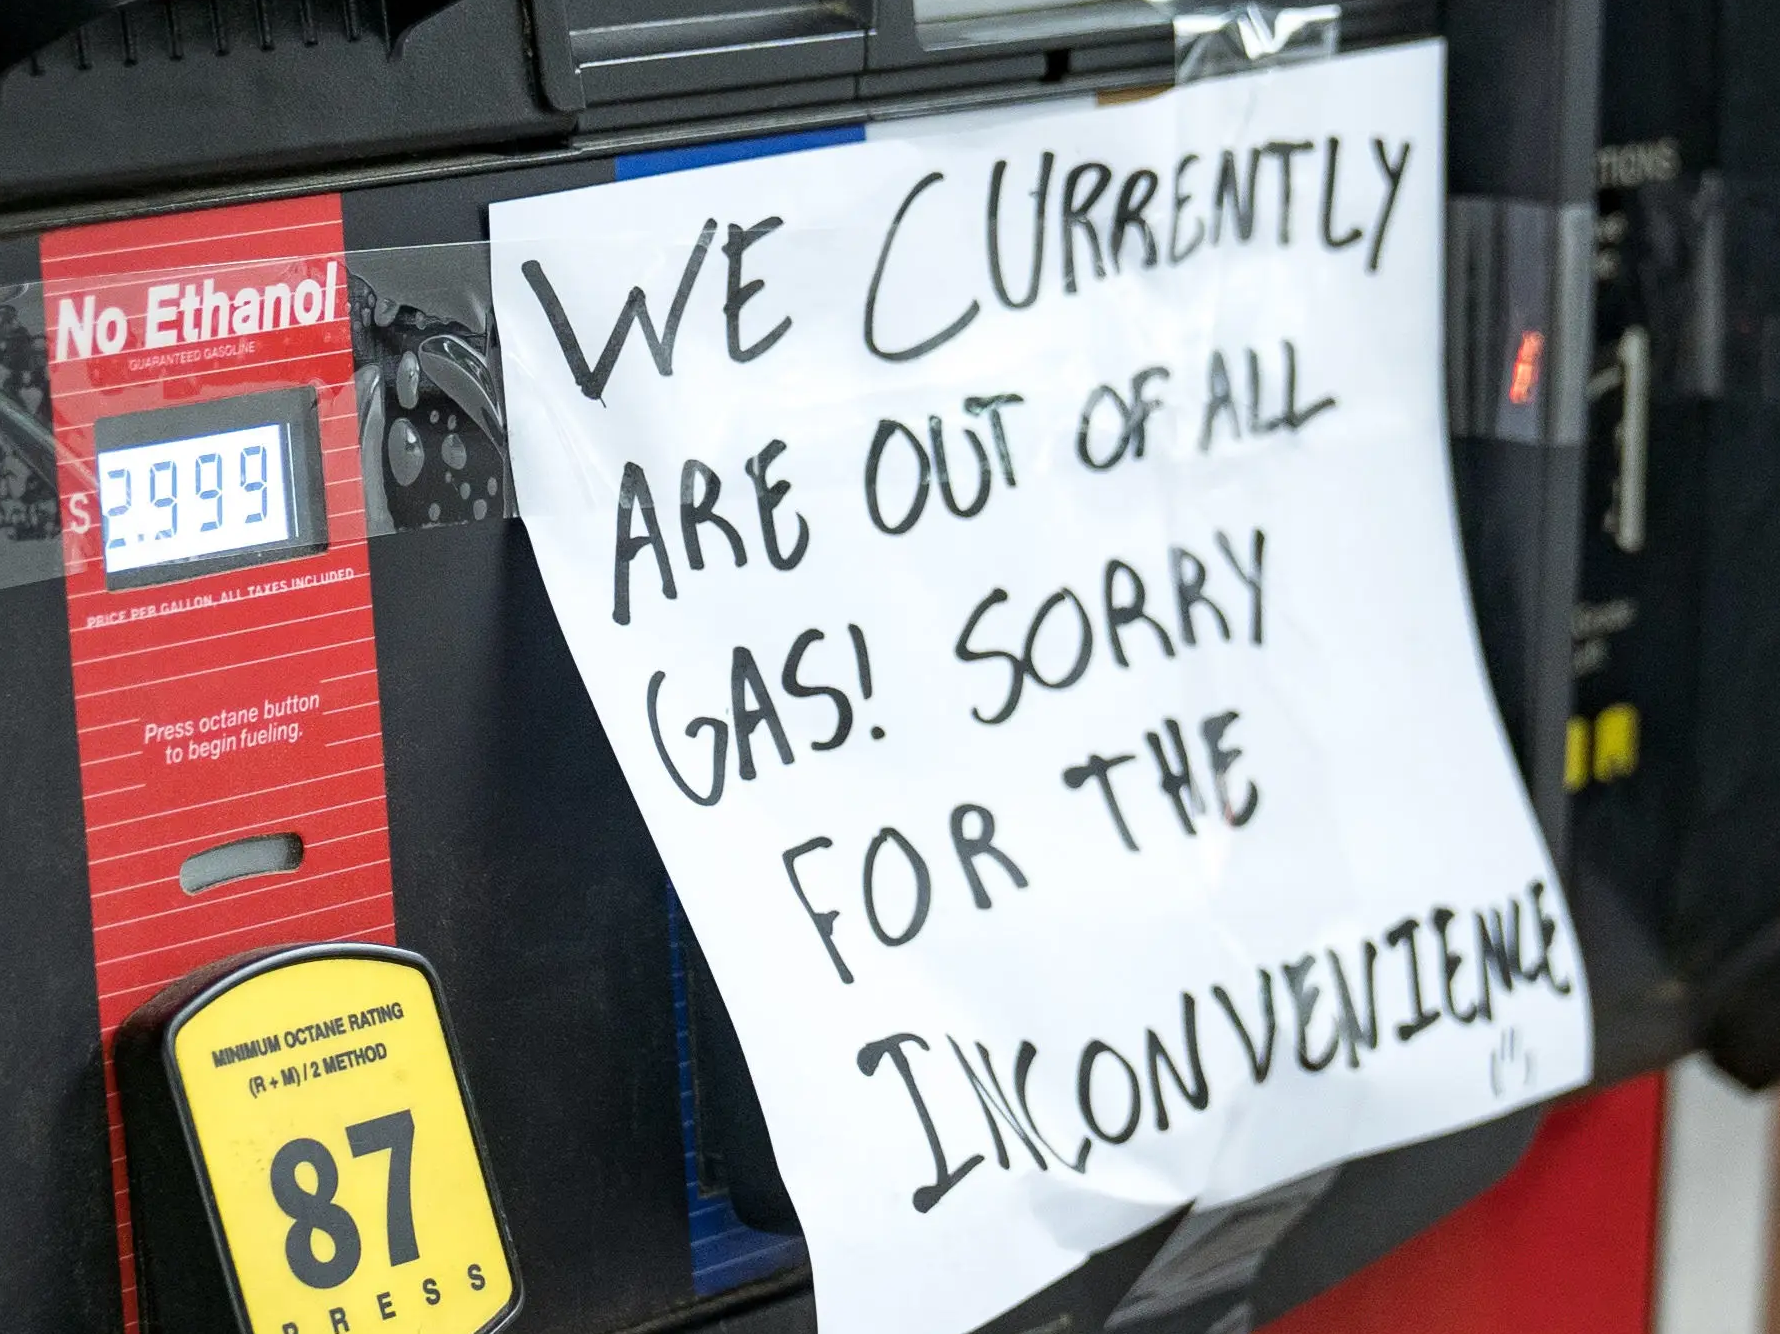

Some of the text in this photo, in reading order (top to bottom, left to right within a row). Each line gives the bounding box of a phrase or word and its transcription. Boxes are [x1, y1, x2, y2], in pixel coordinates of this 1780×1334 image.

[55, 260, 338, 362] No Ethanol
[522, 137, 1412, 407] WE CURRENTLY
[129, 340, 256, 372] GUARANTEED GASOLINE
[613, 340, 1336, 625] ARE OUT OF ALL
[86, 568, 355, 629] PRICE PER GALLON, ALL TAXES INCLUDED
[144, 694, 320, 744] Press octane button
[647, 529, 1265, 807] GAS! SORRY
[165, 722, 304, 764] to begin fueling.
[782, 711, 1259, 985] FOR THE
[211, 1002, 405, 1068] MINIMUM OCTANE RATING
[310, 1061, 321, 1079] 2
[322, 1042, 388, 1075] METHOD
[856, 881, 1572, 1215] INCONVENIENCE
[270, 1108, 421, 1290] 87
